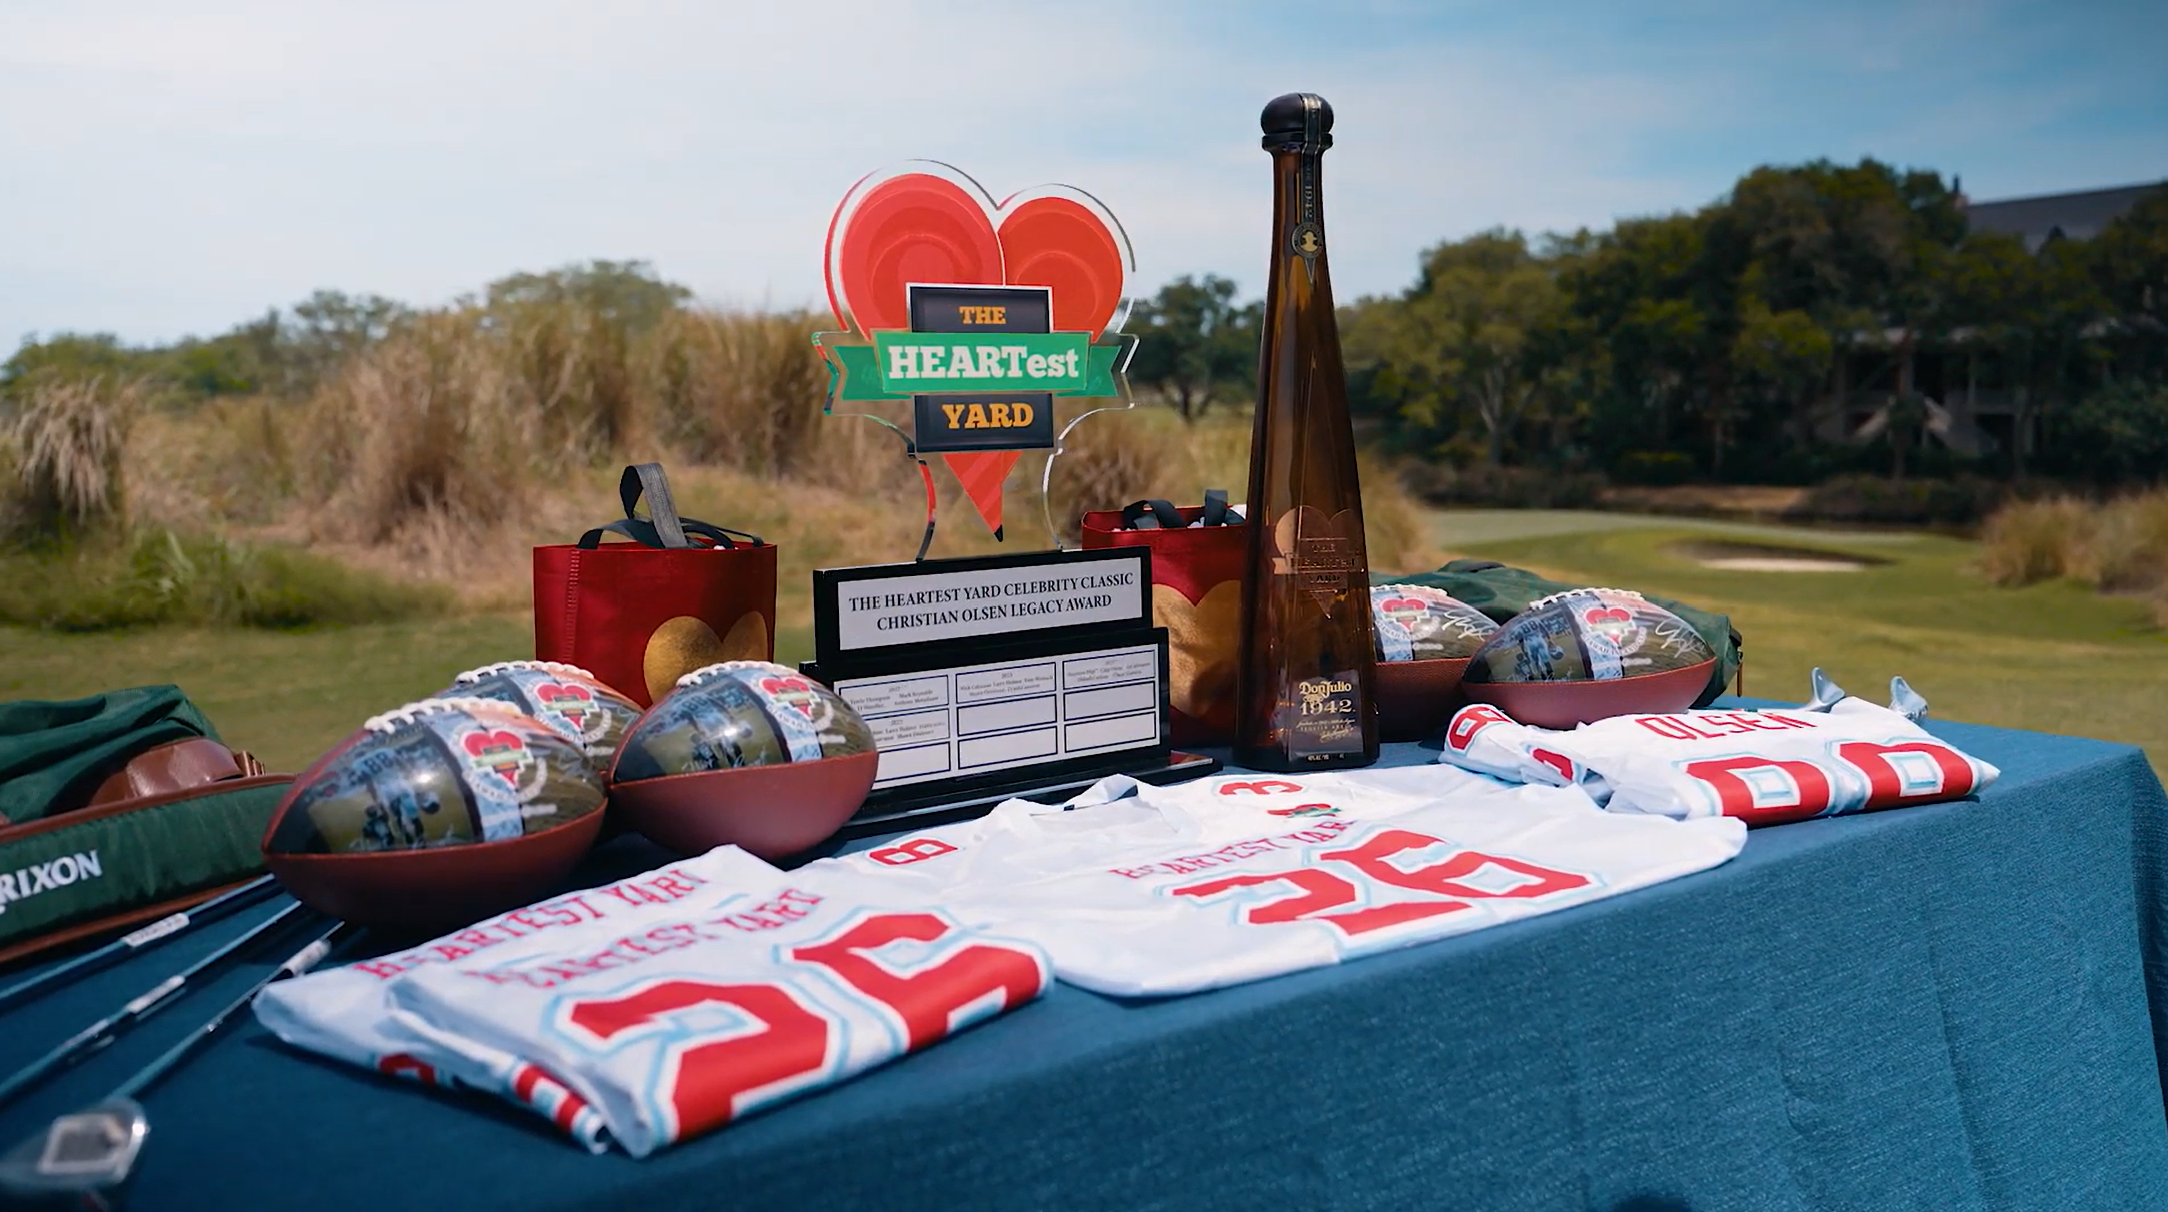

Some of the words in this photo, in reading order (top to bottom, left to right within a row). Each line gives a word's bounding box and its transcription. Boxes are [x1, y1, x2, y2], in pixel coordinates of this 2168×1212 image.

[959, 305, 1006, 325] THE
[888, 345, 1079, 379] HEARTest
[942, 403, 1034, 430] YARD
[849, 596, 881, 612] THE
[884, 588, 961, 608] HEARTEST
[963, 584, 1001, 600] YARD
[1004, 577, 1078, 597] CELEBRITY
[1080, 572, 1134, 590] CLASSIC
[876, 610, 959, 631] CHRISTIAN
[961, 603, 1008, 622] OLSEN
[1011, 598, 1064, 617] LEGACY
[1066, 594, 1112, 611] AWARD
[1300, 699, 1352, 716] 1942
[1635, 713, 1817, 740] OLSEN
[868, 838, 959, 866] 8
[0, 849, 102, 905] RIXON
[1170, 829, 1594, 937] 26
